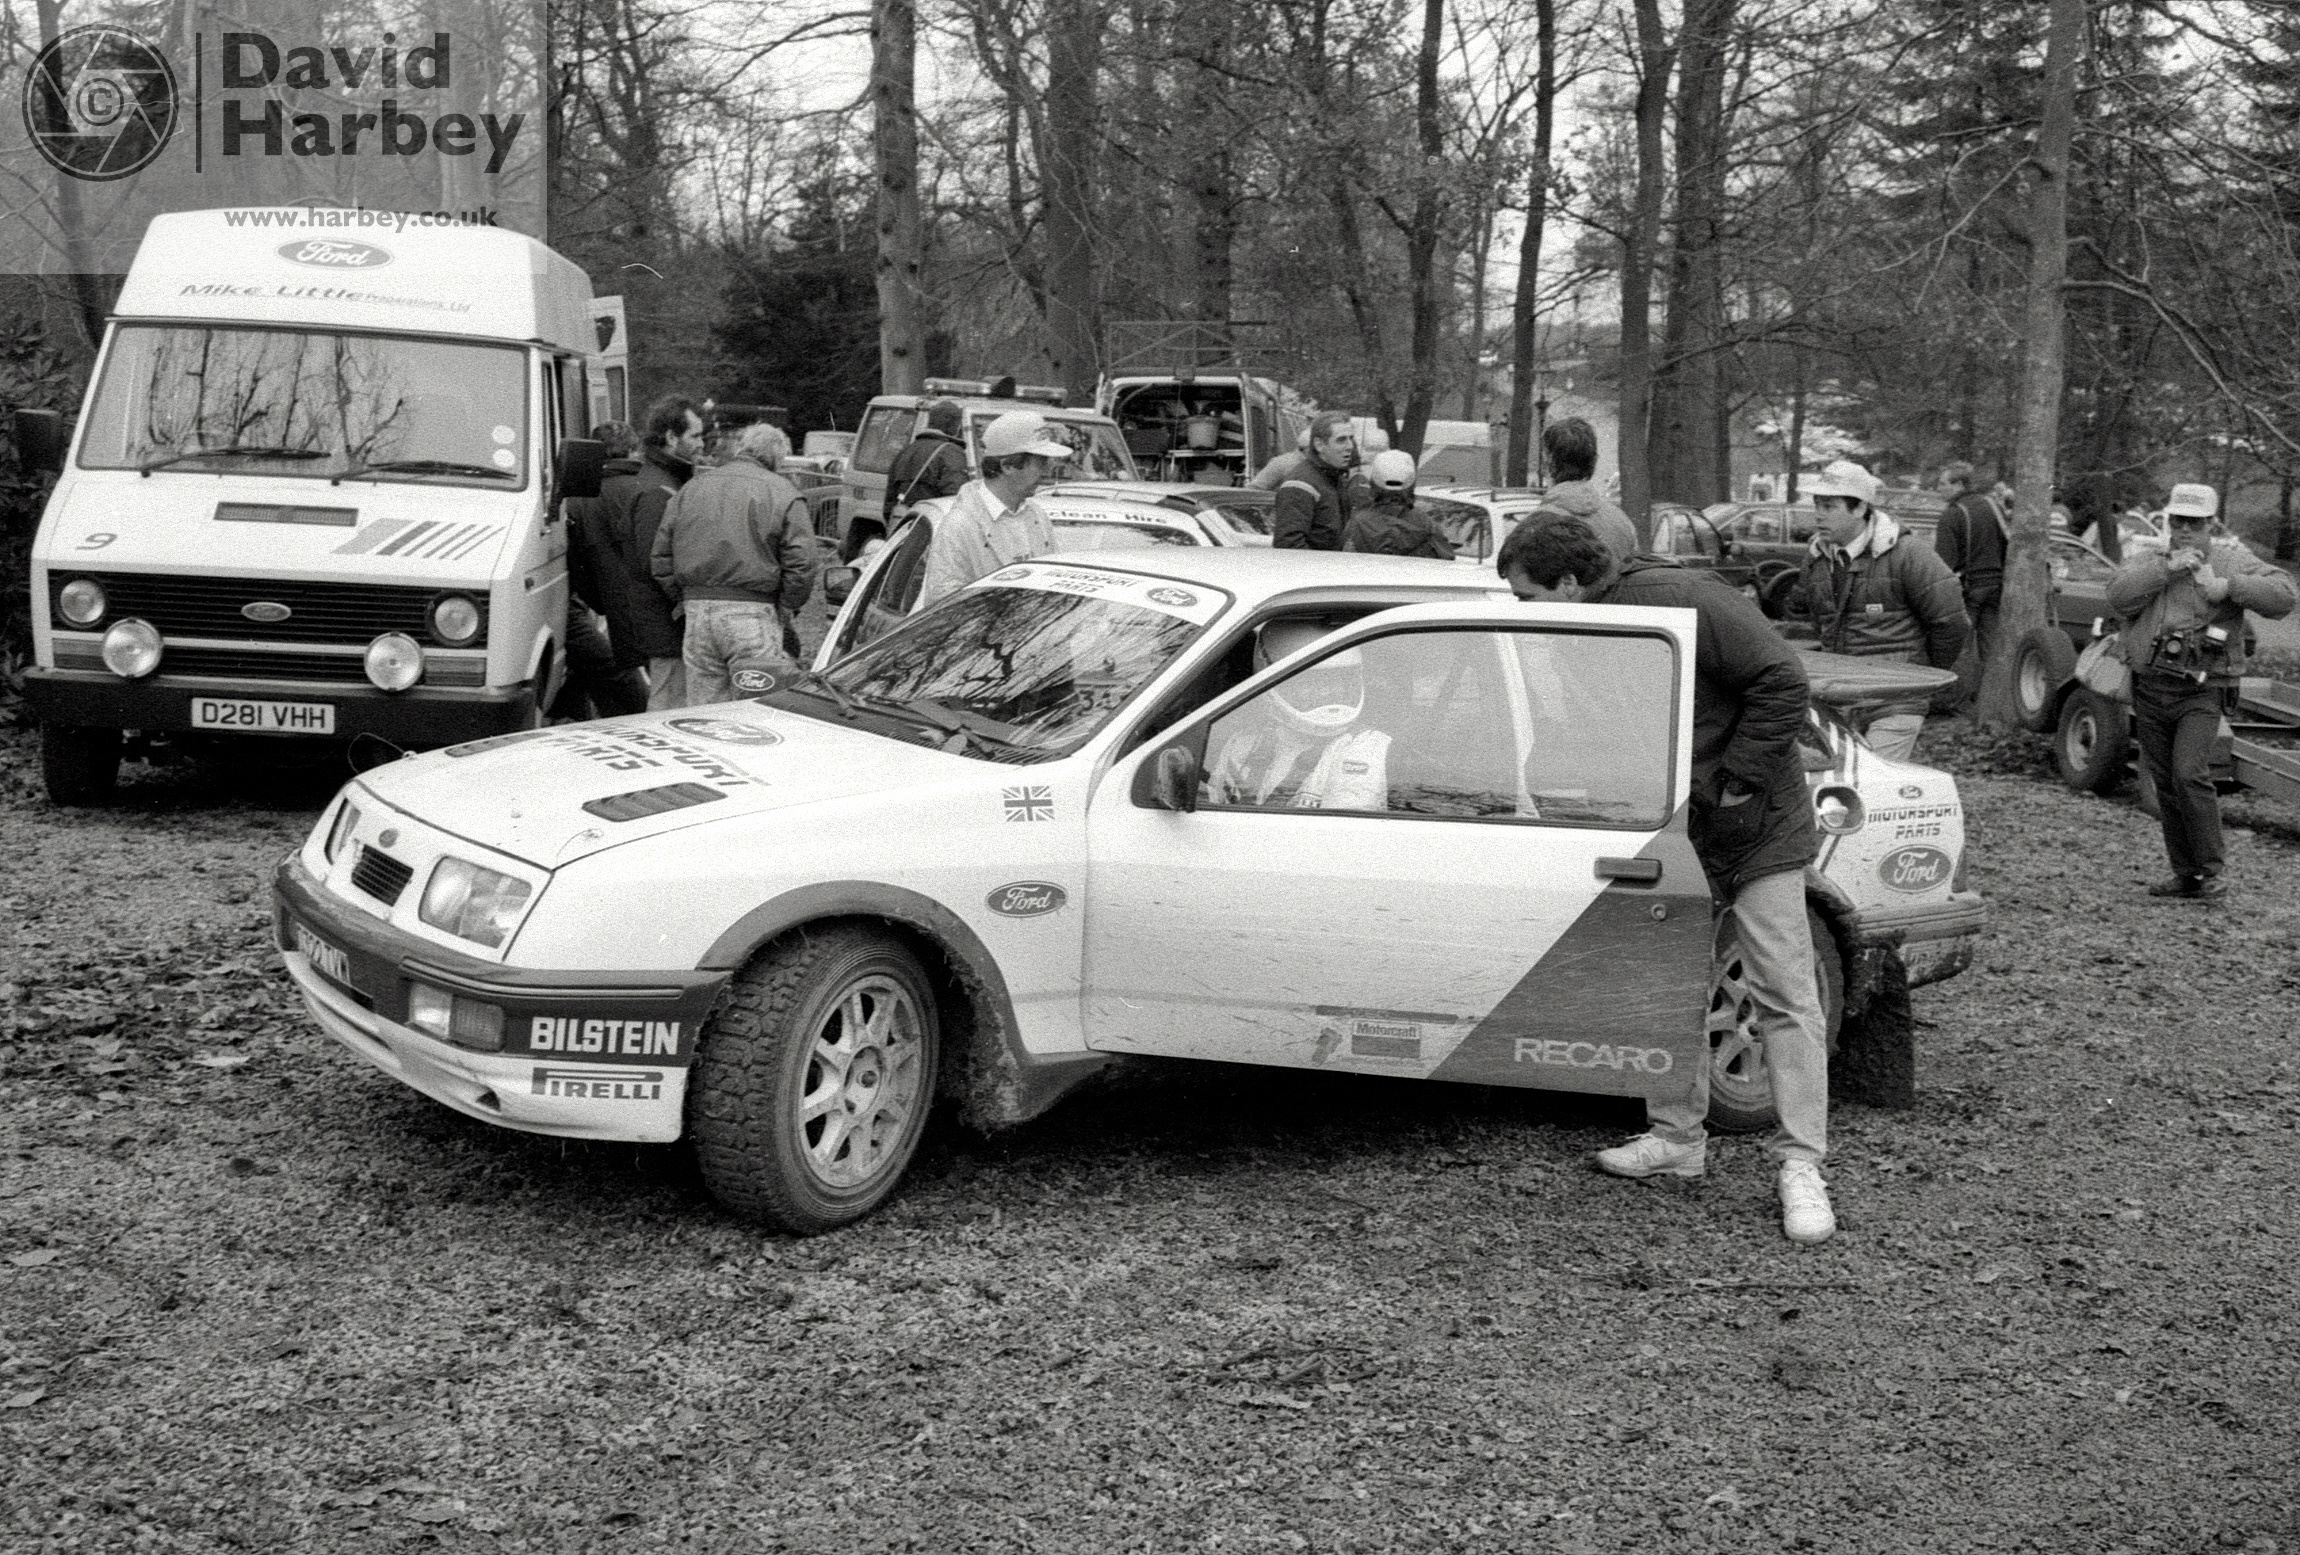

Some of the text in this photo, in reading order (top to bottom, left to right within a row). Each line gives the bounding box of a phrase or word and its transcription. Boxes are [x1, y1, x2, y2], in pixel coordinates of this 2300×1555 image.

[296, 241, 368, 265] Ford
[179, 284, 261, 298] Mike
[277, 286, 364, 301] Little
[1125, 513, 1167, 523] Hire
[75, 532, 118, 550] 9
[739, 672, 766, 687] Ford
[202, 702, 326, 728] D281 VHH
[1868, 804, 1958, 823] MOTORSPORT
[1895, 822, 1941, 839] PARTS
[1893, 852, 1940, 884] Ford
[1002, 886, 1052, 910] Ford
[530, 1016, 681, 1055] BILSTEIN
[1356, 1022, 1417, 1038] Motorcraft
[1514, 1038, 1673, 1075] RECARO
[531, 1067, 664, 1100] PIRELLI
